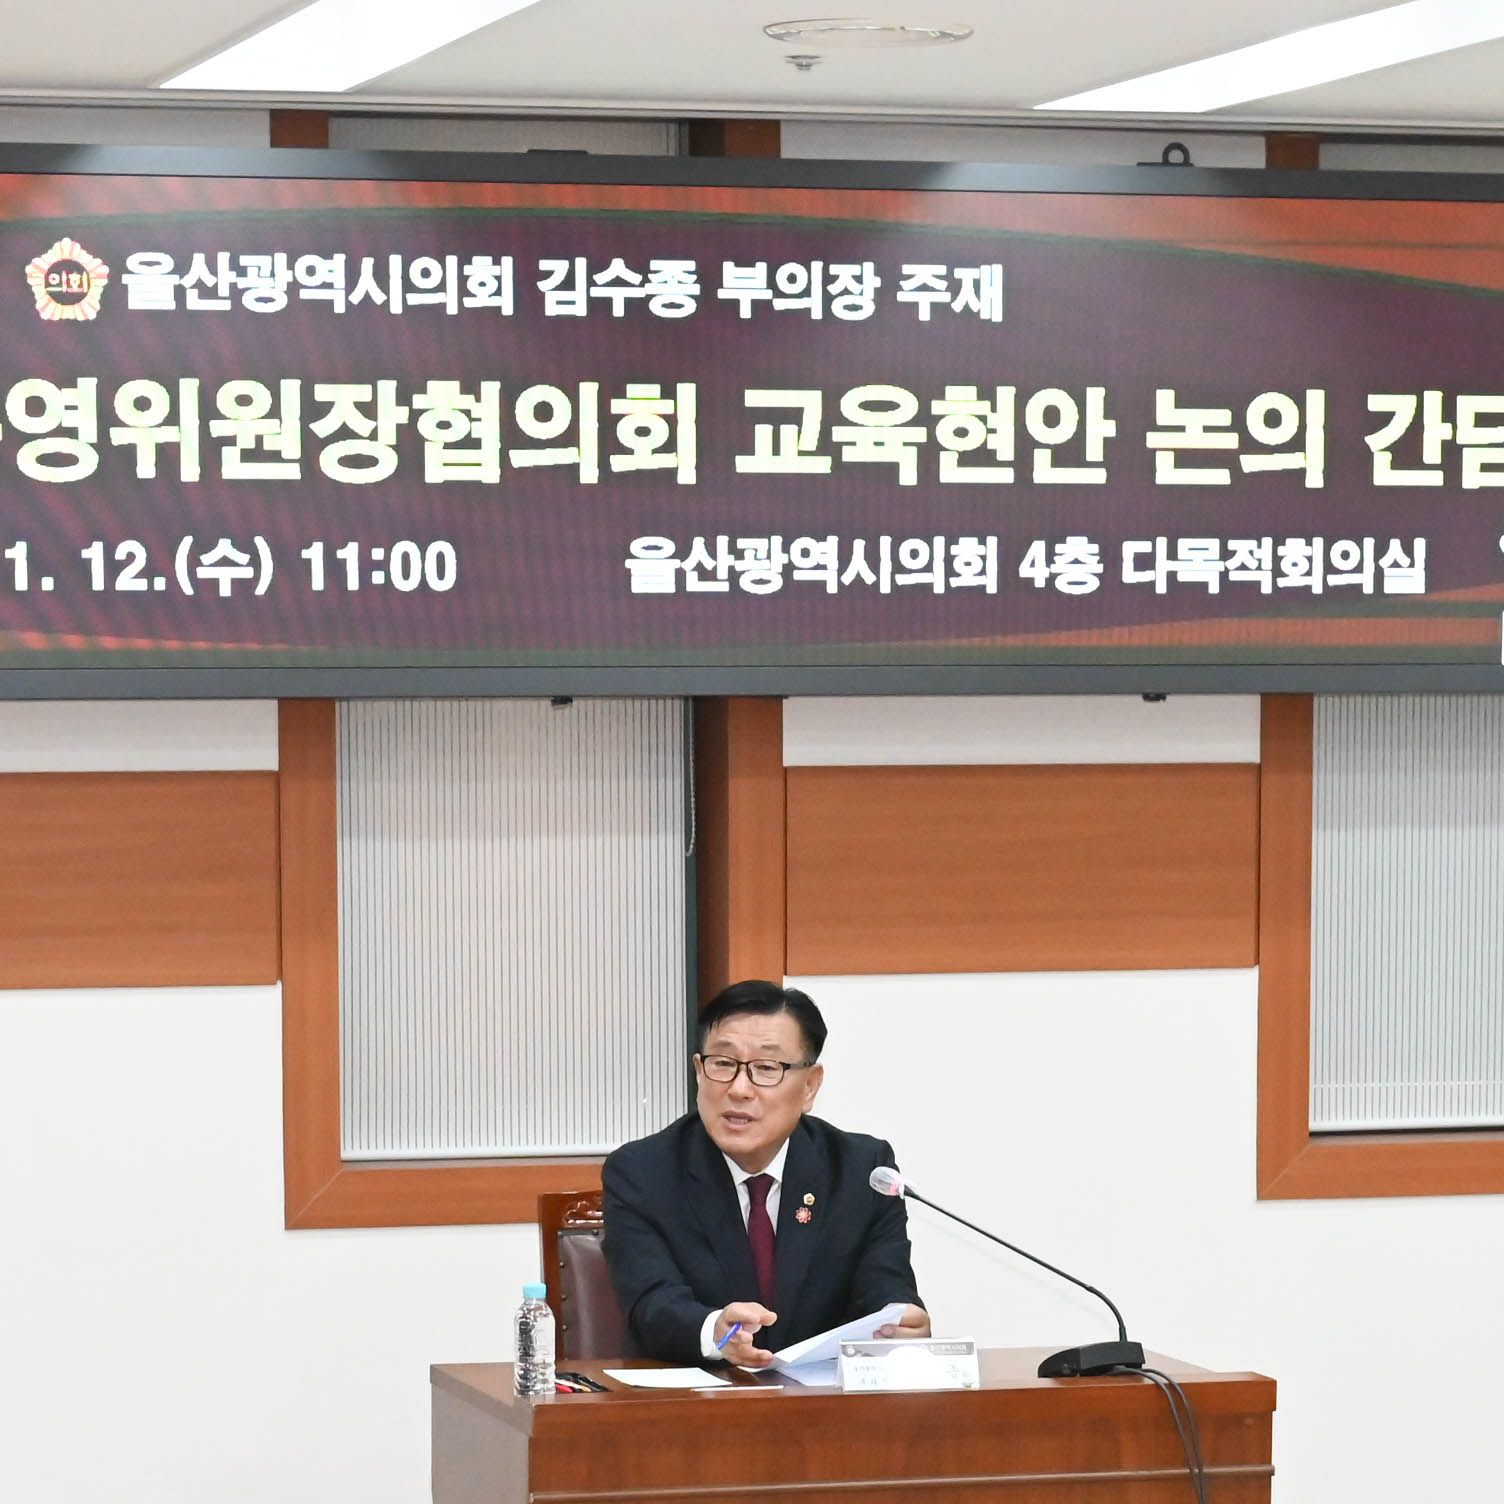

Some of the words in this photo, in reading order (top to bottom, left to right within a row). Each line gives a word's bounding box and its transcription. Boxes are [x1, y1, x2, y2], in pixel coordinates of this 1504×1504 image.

[122, 252, 513, 316] 울산광역시의회
[537, 258, 700, 318] 김수종
[718, 261, 881, 321] 부의장
[897, 264, 1003, 323] 주재
[735, 385, 1116, 486] 교육현안
[1146, 389, 1325, 489] 논의
[82, 536, 274, 598] 12.(수)
[302, 541, 457, 592] 11:00
[625, 536, 998, 595] 울산광역시의회
[1019, 537, 1104, 595] 4층
[1122, 537, 1427, 595] 다목적회의실
